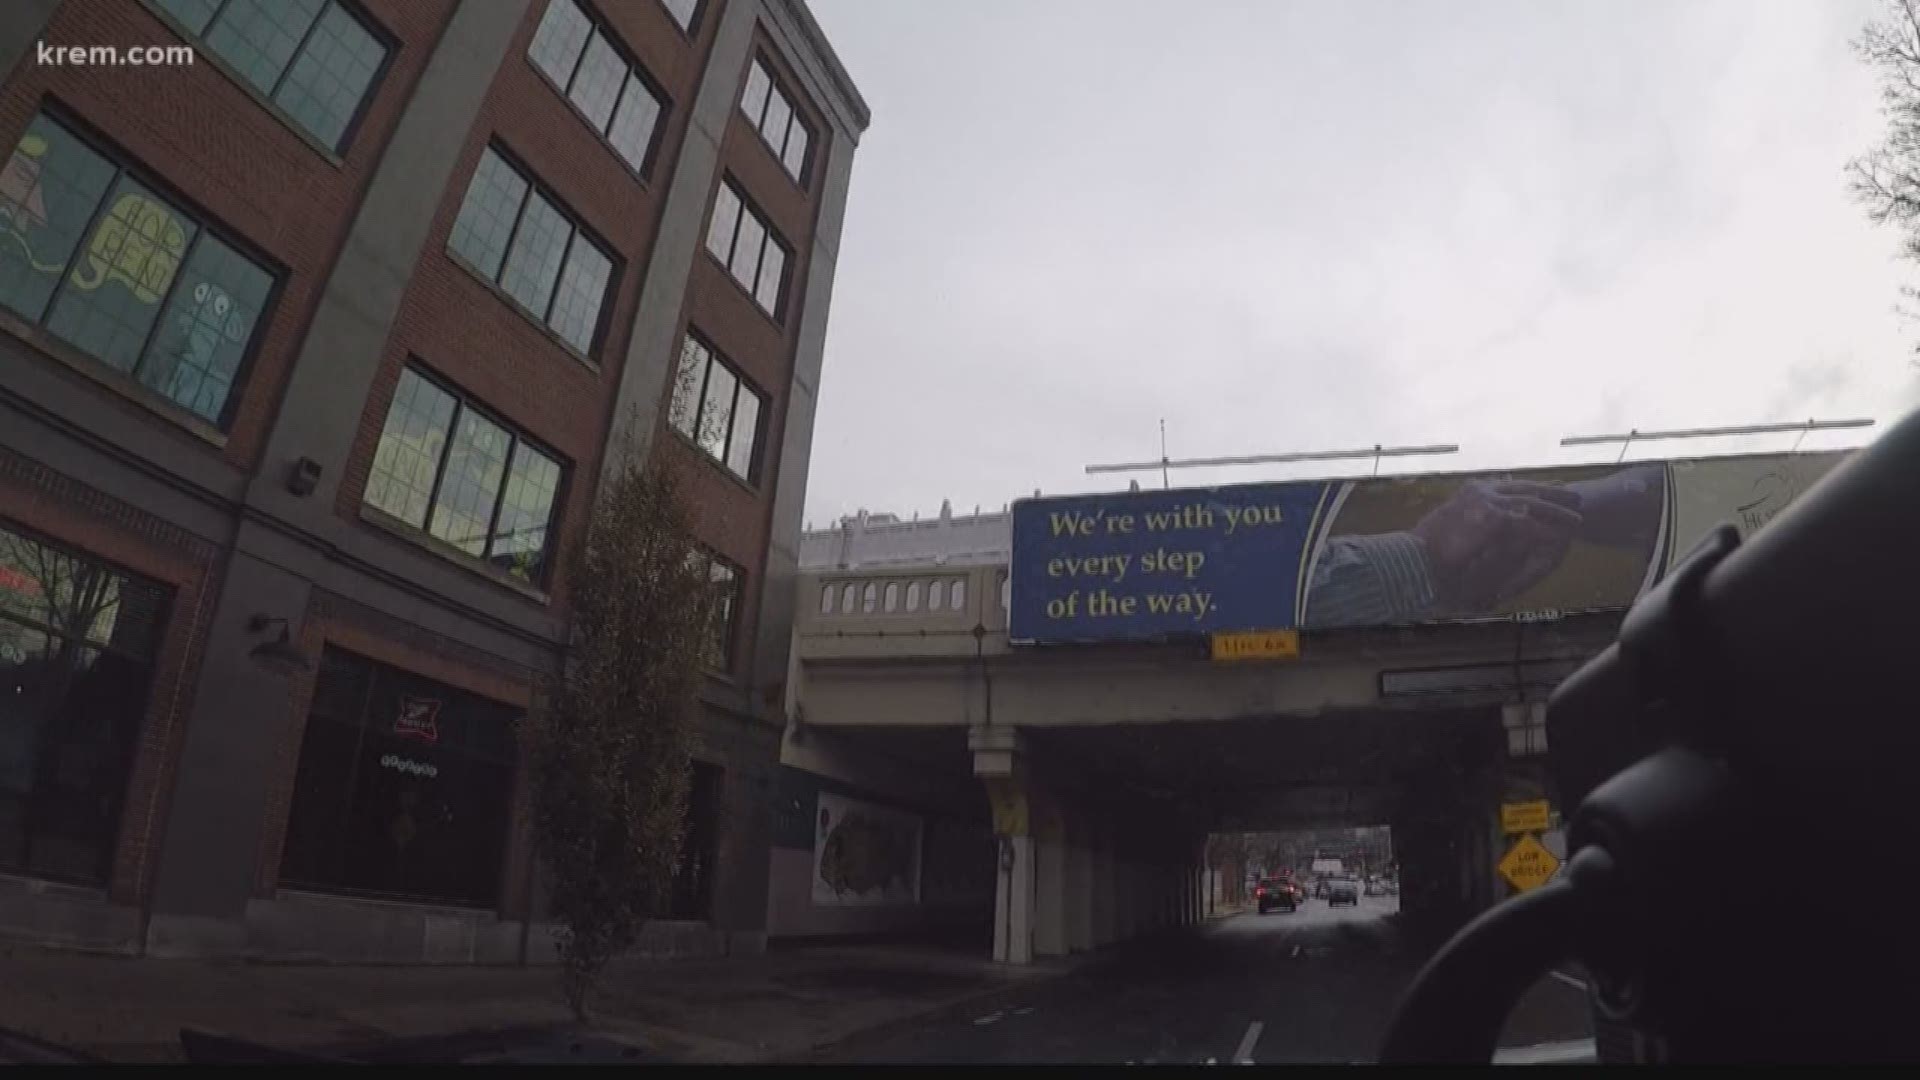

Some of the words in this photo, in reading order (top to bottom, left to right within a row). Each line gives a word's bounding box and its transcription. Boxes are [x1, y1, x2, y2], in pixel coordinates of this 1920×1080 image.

[1050, 508, 1135, 538] We're
[1144, 503, 1213, 530] with
[1223, 503, 1283, 535] you
[1047, 553, 1132, 583] every
[1140, 546, 1206, 578] step
[1046, 589, 1080, 619] of
[1087, 588, 1137, 616] the
[1146, 592, 1218, 620] way.
